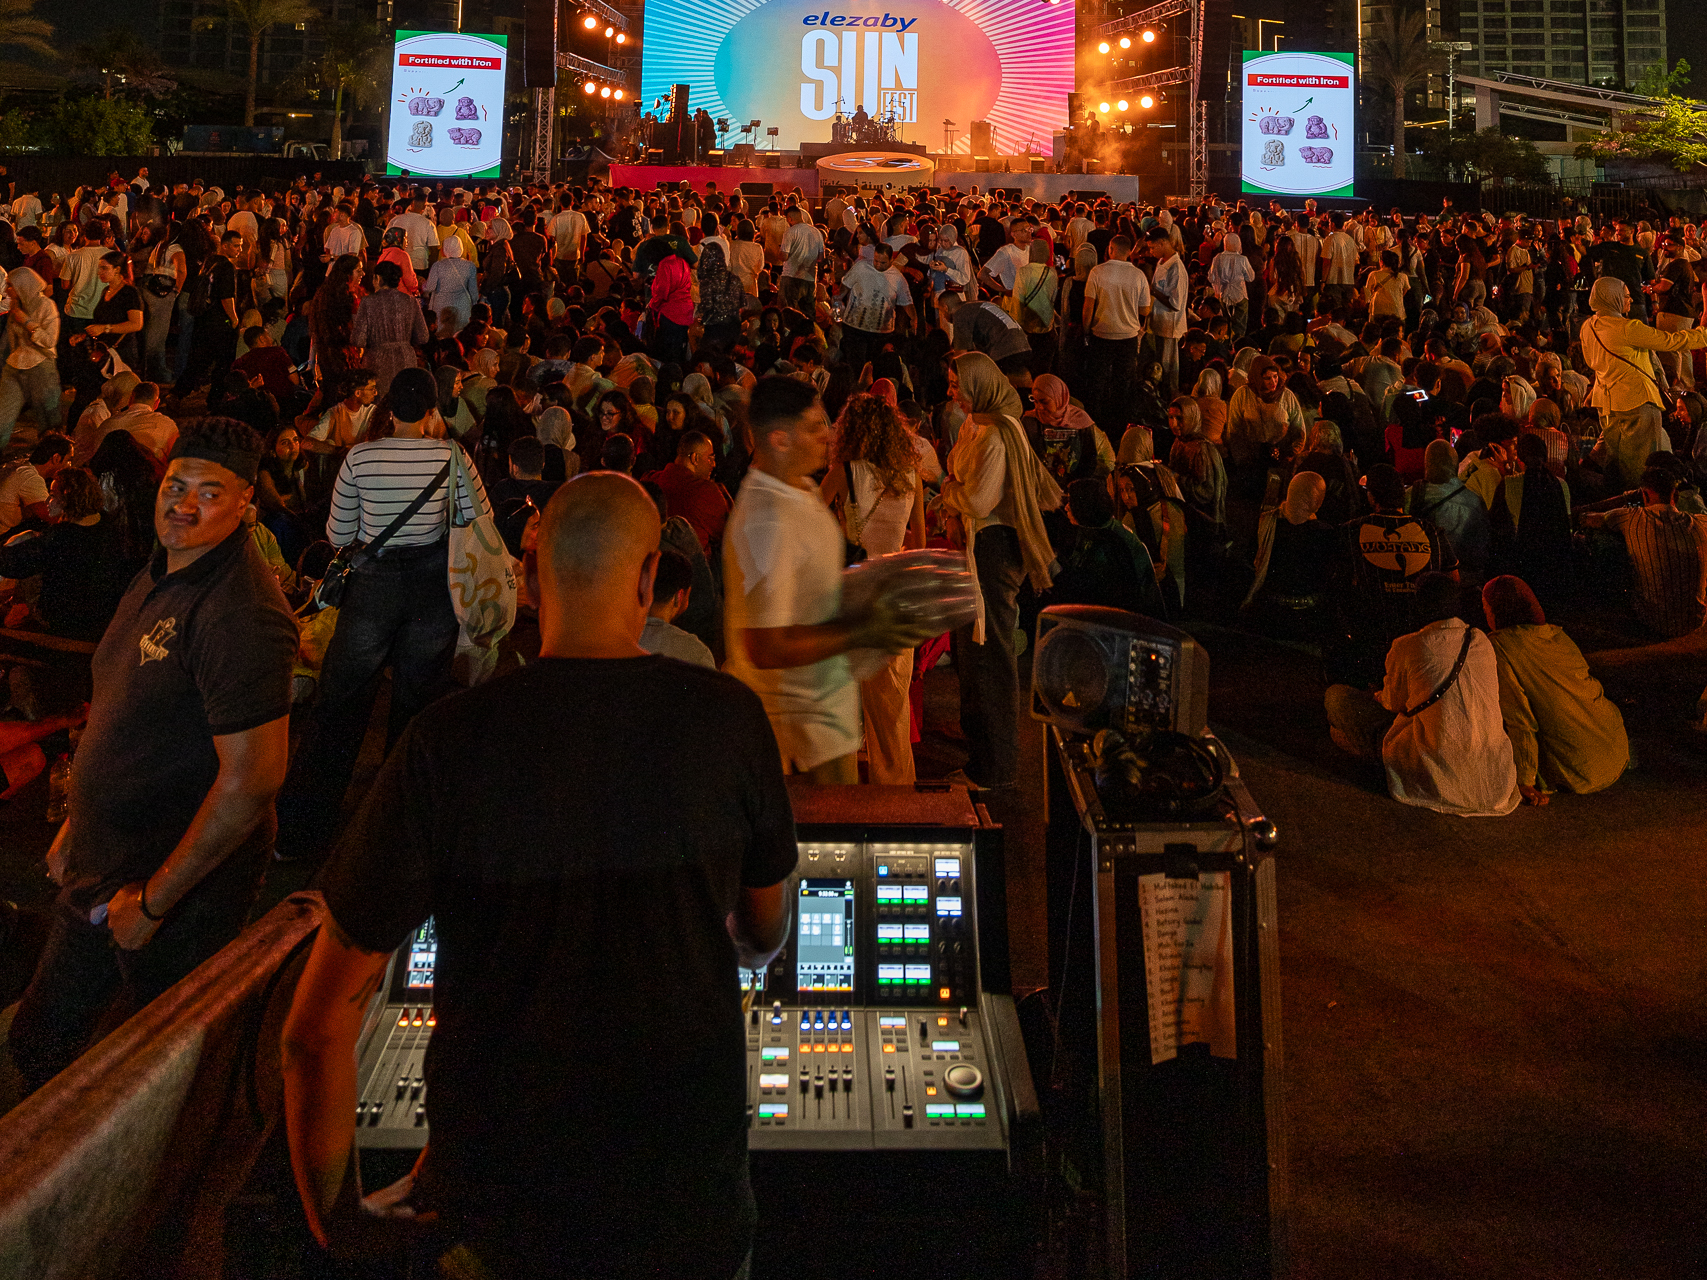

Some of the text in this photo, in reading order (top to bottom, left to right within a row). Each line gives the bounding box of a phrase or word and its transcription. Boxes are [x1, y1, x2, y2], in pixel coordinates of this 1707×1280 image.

[802, 11, 918, 32] elezaby
[408, 56, 492, 67] Fortified with Iron
[800, 29, 919, 121] SUN
[1257, 76, 1339, 85] Fortified with Iron
